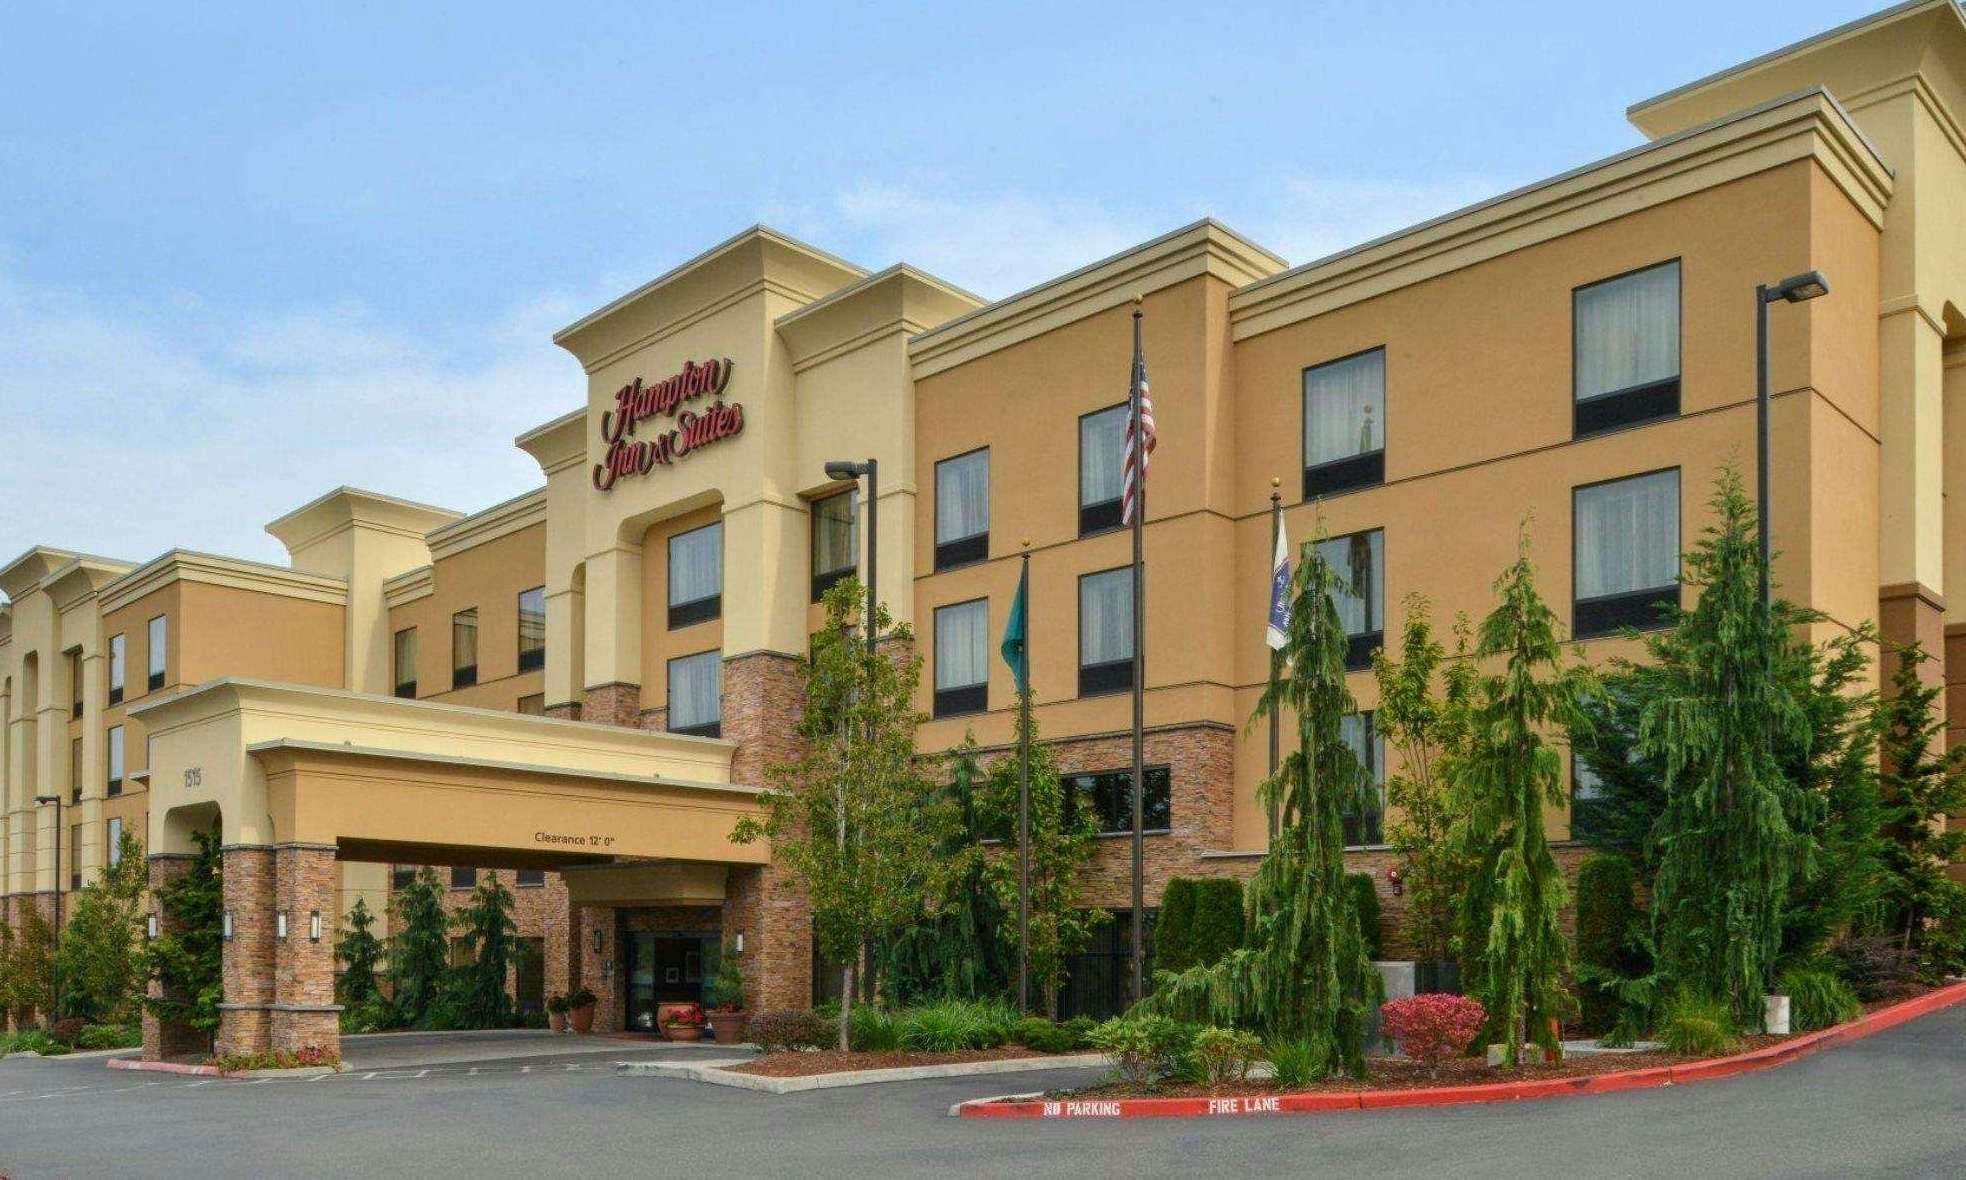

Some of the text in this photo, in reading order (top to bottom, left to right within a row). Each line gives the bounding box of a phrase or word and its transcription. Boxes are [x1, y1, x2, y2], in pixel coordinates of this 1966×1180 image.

[601, 358, 735, 444] Hampton
[593, 439, 657, 491] Inn
[668, 400, 744, 457] Suites
[535, 832, 585, 845] Clearance
[1043, 1102, 1120, 1116] NO PARKING
[1209, 1097, 1280, 1115] FIRE LANE
